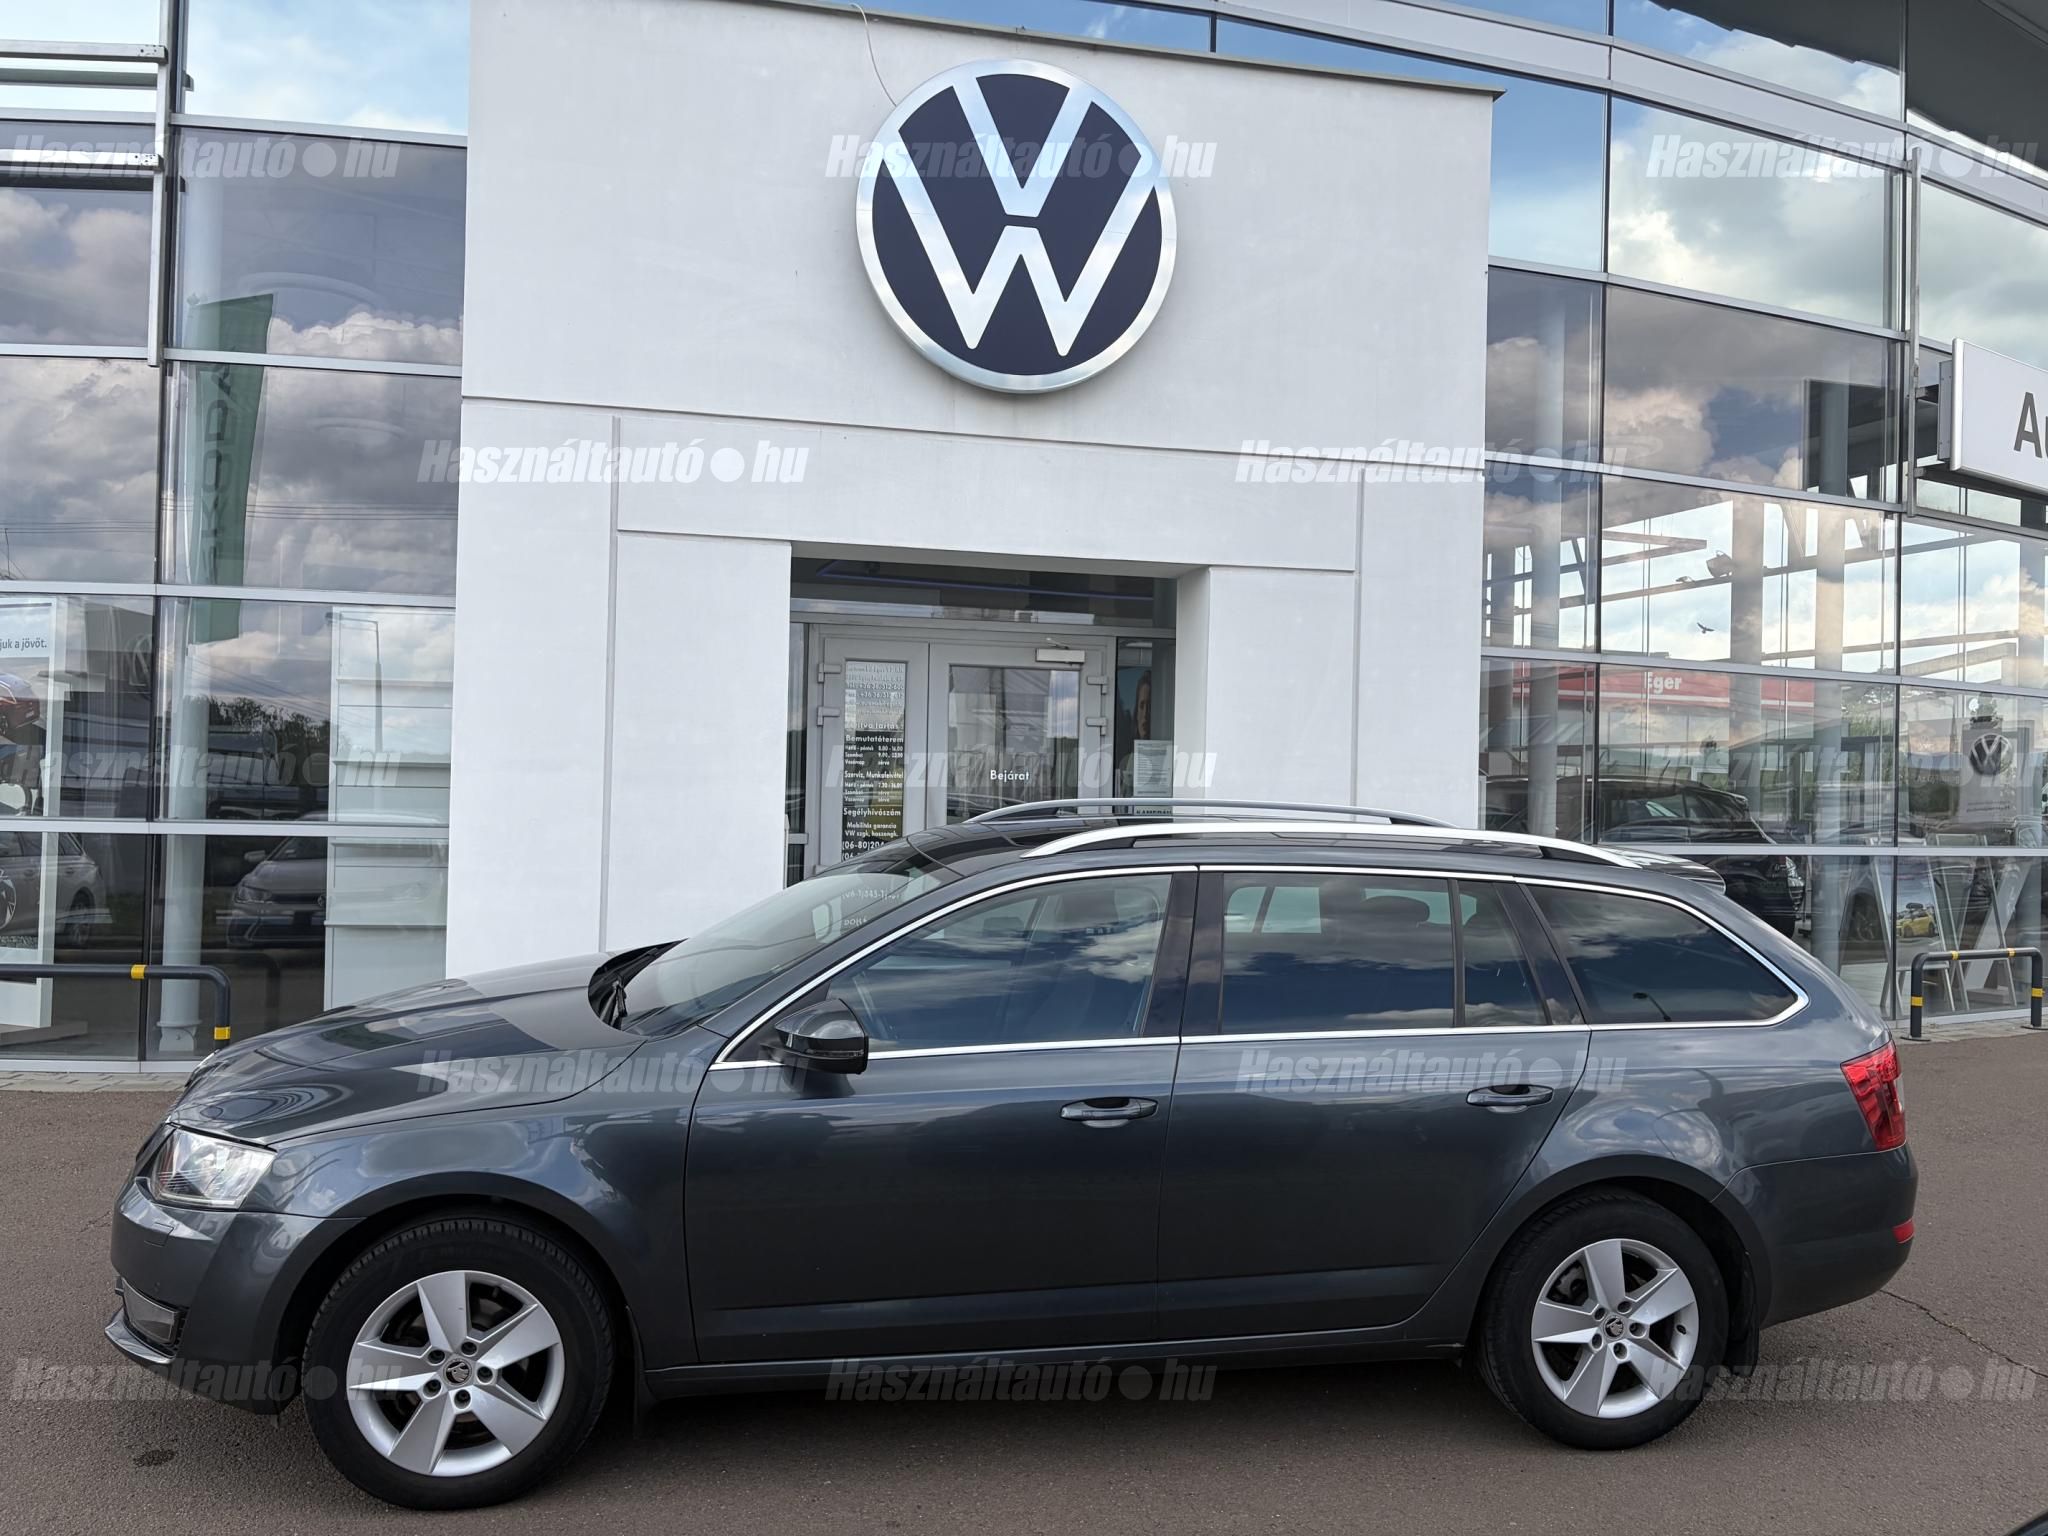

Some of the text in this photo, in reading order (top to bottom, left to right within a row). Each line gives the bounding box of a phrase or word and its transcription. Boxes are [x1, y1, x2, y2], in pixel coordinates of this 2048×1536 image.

[868, 60, 1164, 358] VW
[14, 640, 20, 649] a
[1644, 671, 1682, 695] Eger
[846, 735, 904, 743] Bemutatóterem
[989, 769, 1030, 783] Bejárat
